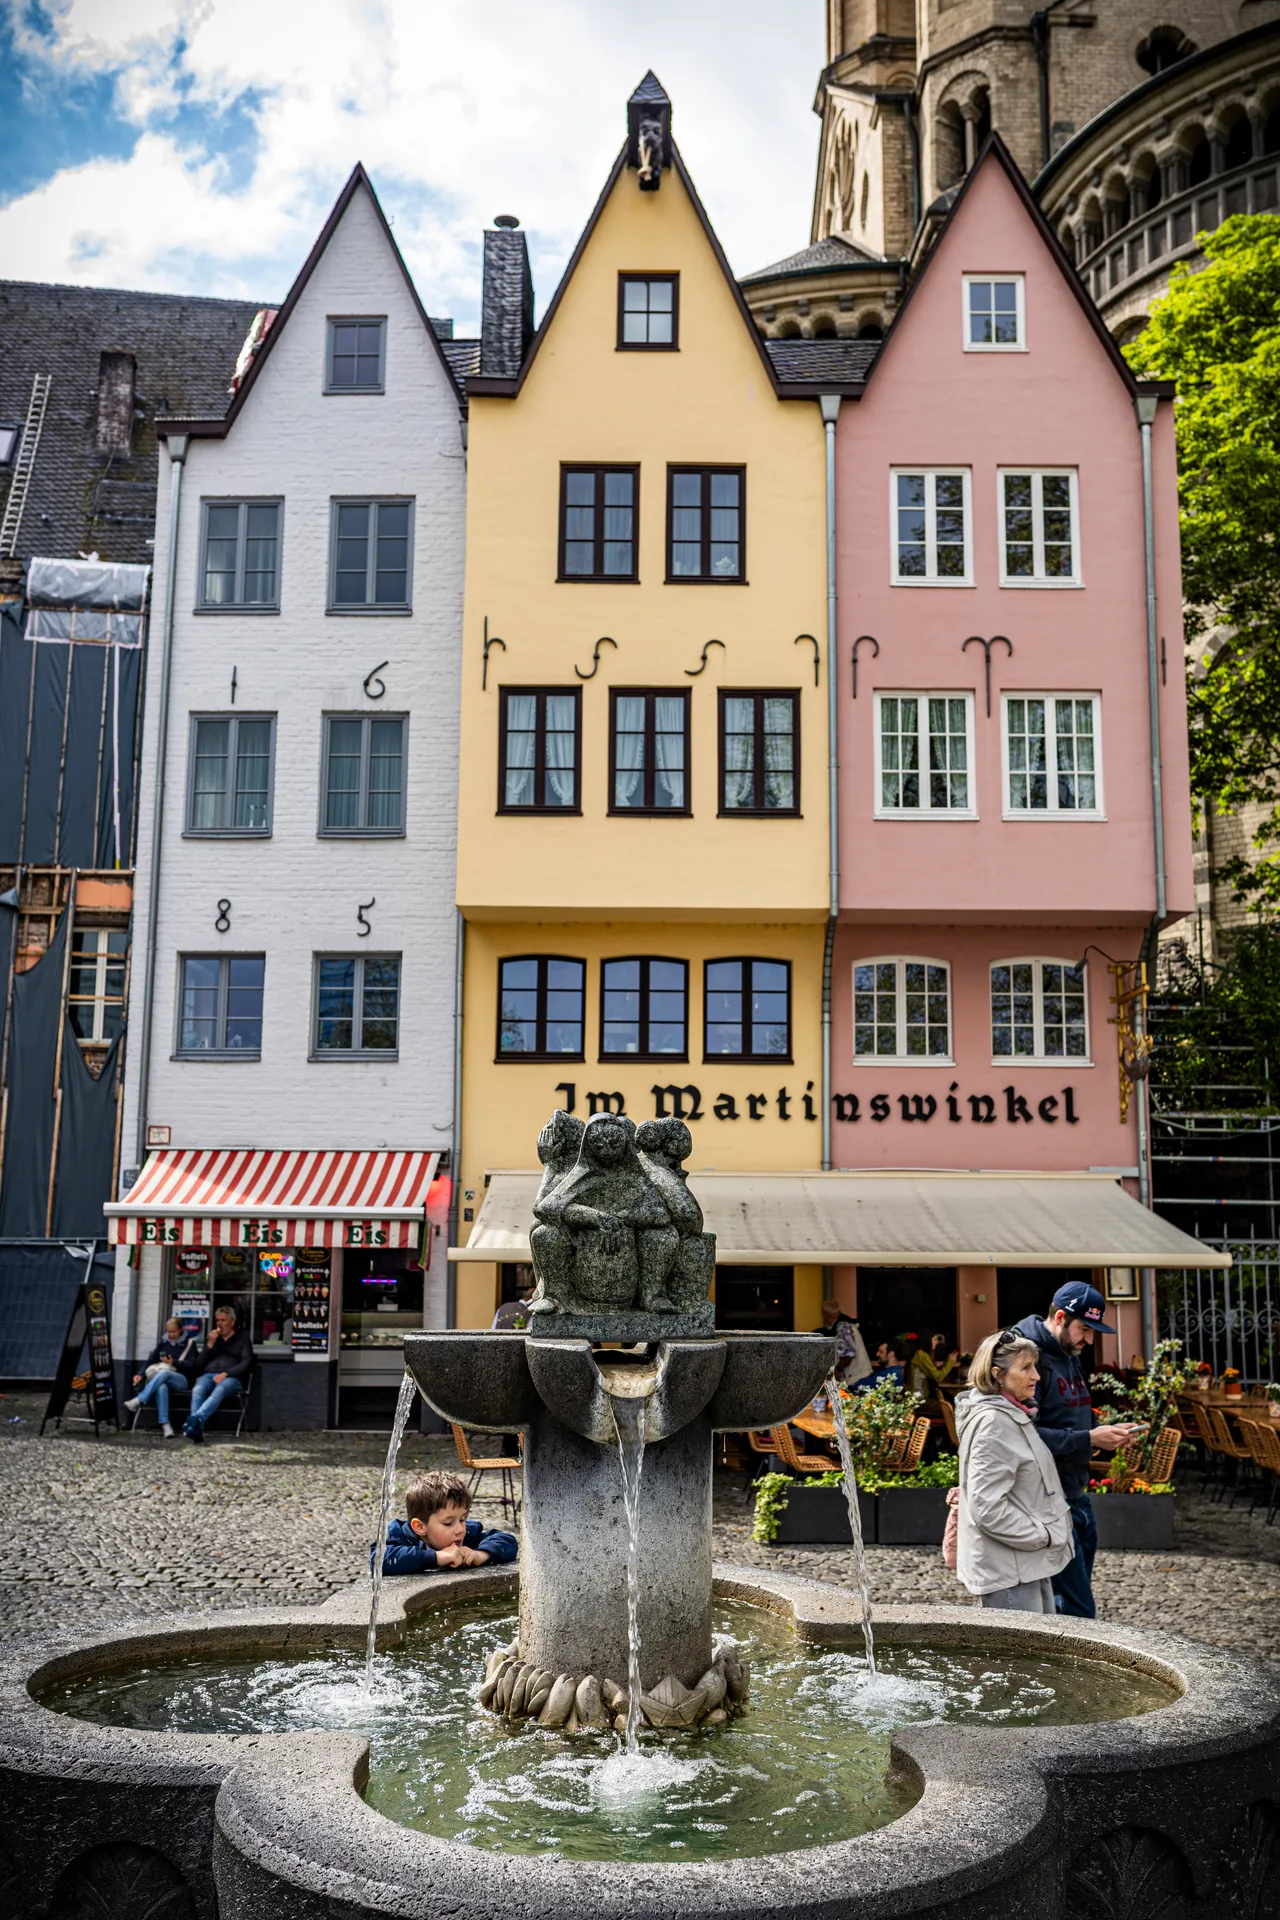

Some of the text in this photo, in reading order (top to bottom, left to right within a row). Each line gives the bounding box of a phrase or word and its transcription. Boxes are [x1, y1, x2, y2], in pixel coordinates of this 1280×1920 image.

[363, 660, 389, 699] 6
[214, 896, 376, 937] 8 5
[650, 1081, 1080, 1124] Martinswinkel
[139, 1222, 181, 1242] Eis
[242, 1223, 283, 1243] Eis
[345, 1225, 388, 1245] Eis
[180, 1252, 208, 1261] Softeis
[298, 1321, 323, 1329] Softeis
